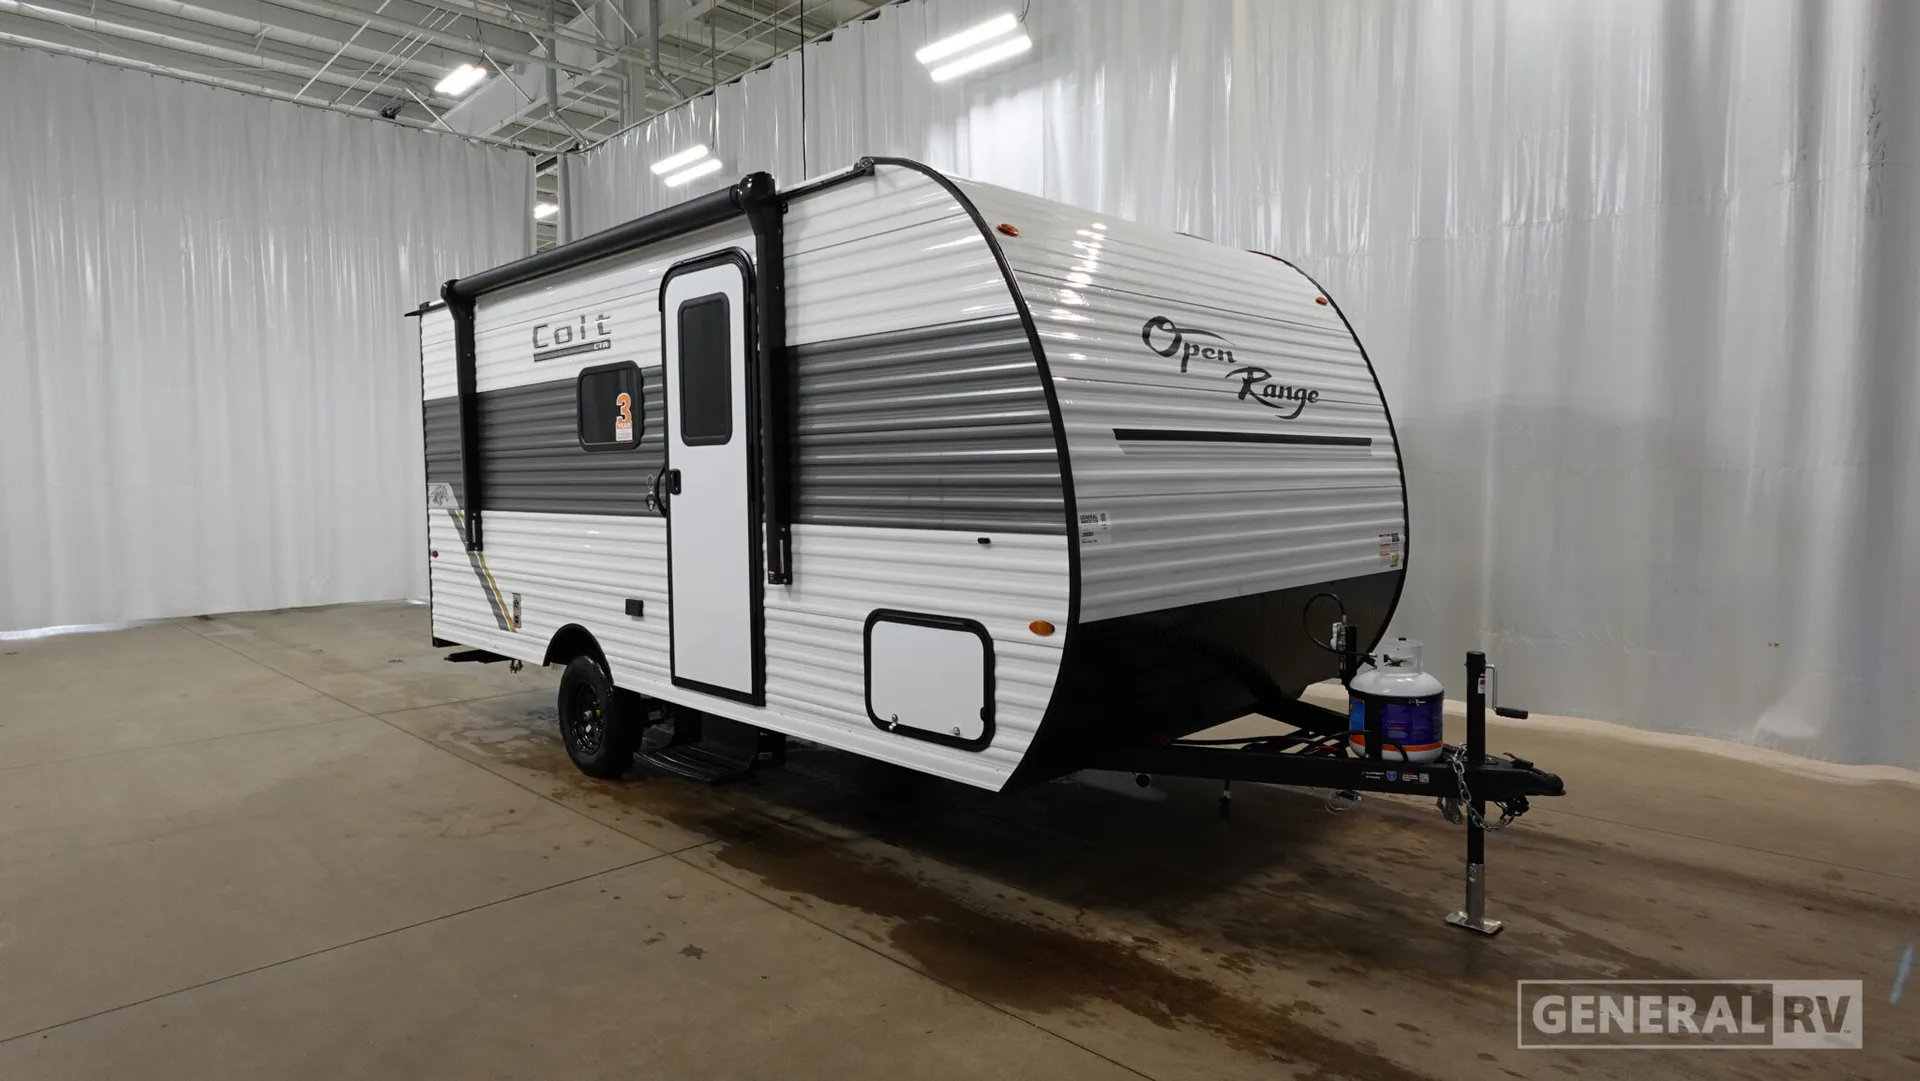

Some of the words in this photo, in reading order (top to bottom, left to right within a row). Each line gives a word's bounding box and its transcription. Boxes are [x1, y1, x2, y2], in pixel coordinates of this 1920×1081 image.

[533, 313, 611, 348] Colt
[1142, 316, 1236, 373] Open
[616, 393, 631, 424] 3
[1225, 366, 1319, 419] Range
